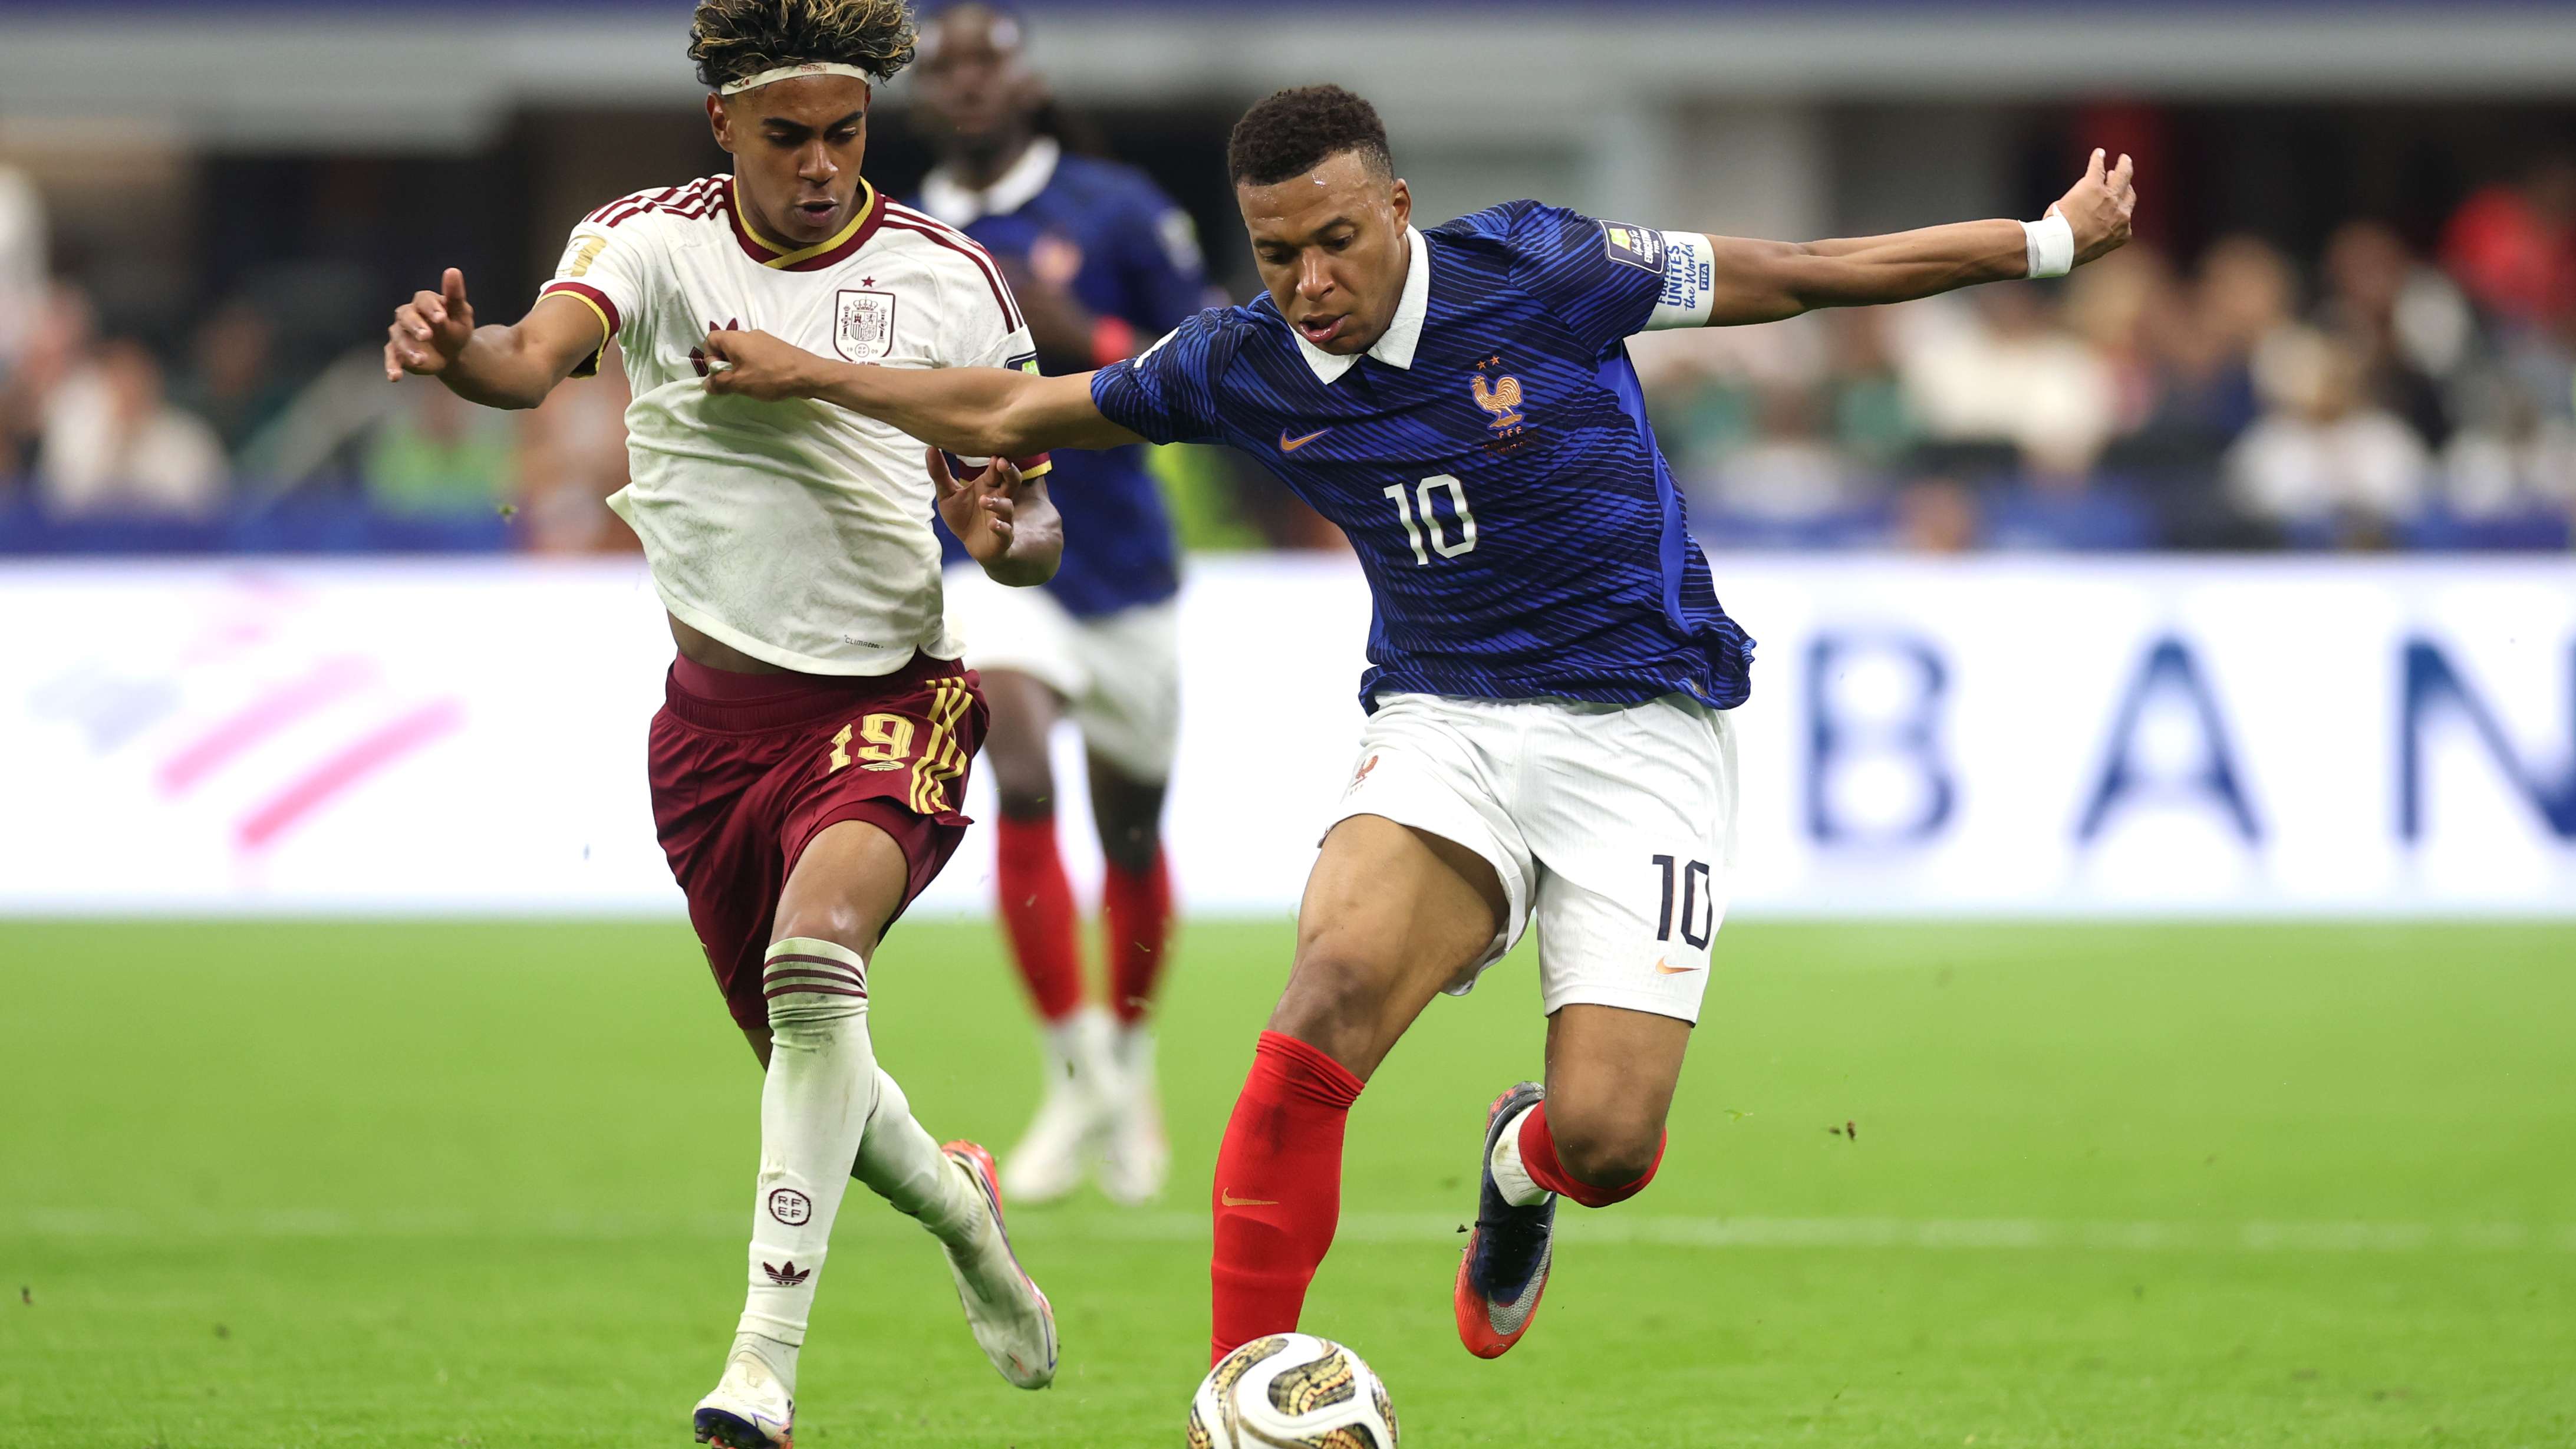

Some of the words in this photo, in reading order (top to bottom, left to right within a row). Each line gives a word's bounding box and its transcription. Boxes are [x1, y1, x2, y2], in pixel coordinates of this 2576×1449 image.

[1666, 245, 1682, 306] UNITES
[1679, 242, 1696, 284] World
[1684, 286, 1695, 311] the
[1383, 473, 1478, 565] 10
[829, 713, 914, 774] 19
[1652, 854, 1713, 951] 10
